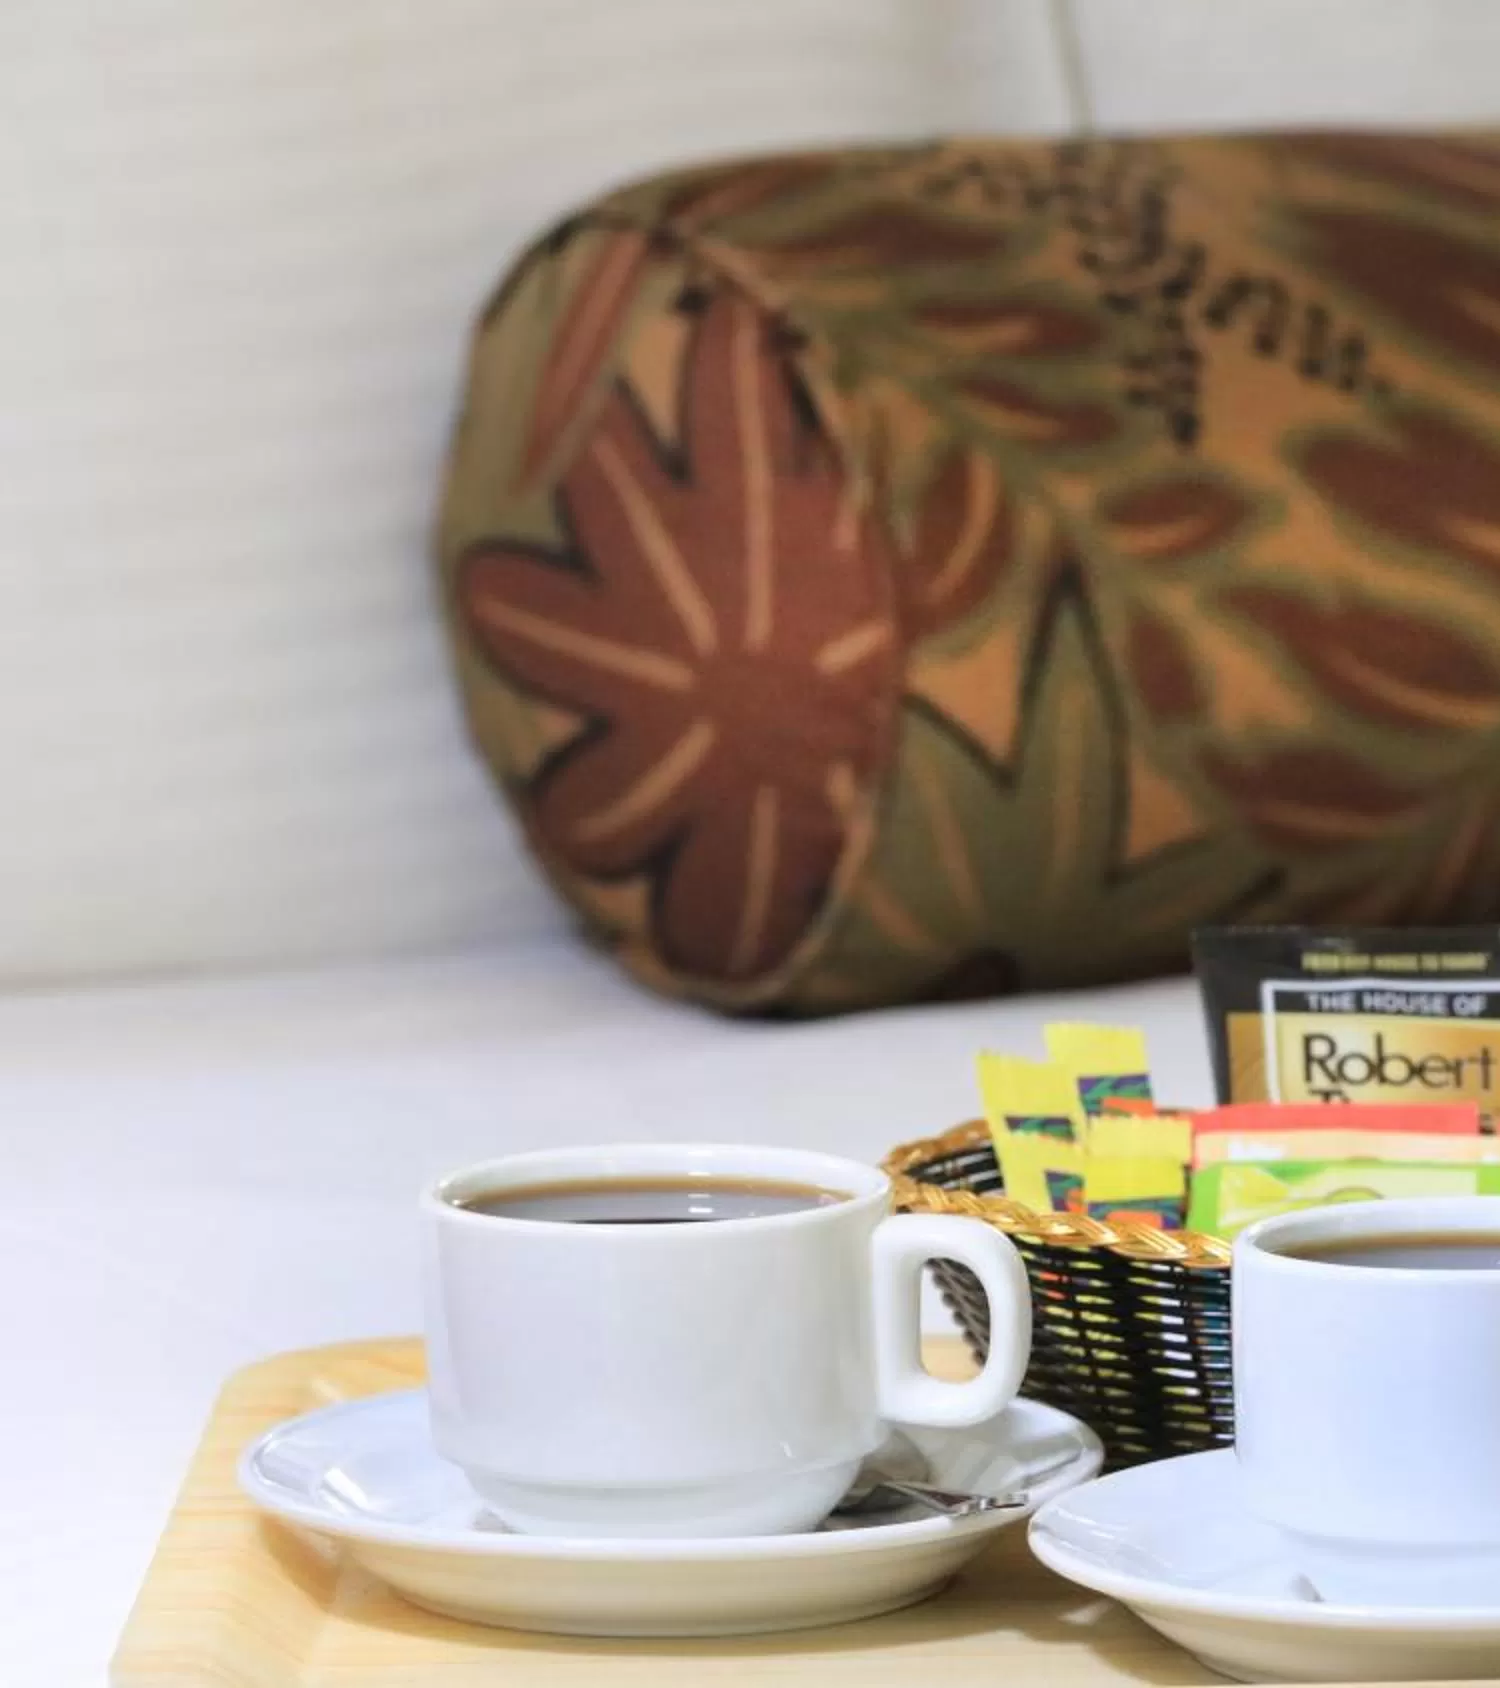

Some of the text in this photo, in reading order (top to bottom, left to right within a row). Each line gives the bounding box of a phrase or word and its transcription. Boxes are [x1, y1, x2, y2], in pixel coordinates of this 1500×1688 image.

[1306, 992, 1487, 1016] THE HOUSE OF
[1303, 1032, 1498, 1090] Robert
